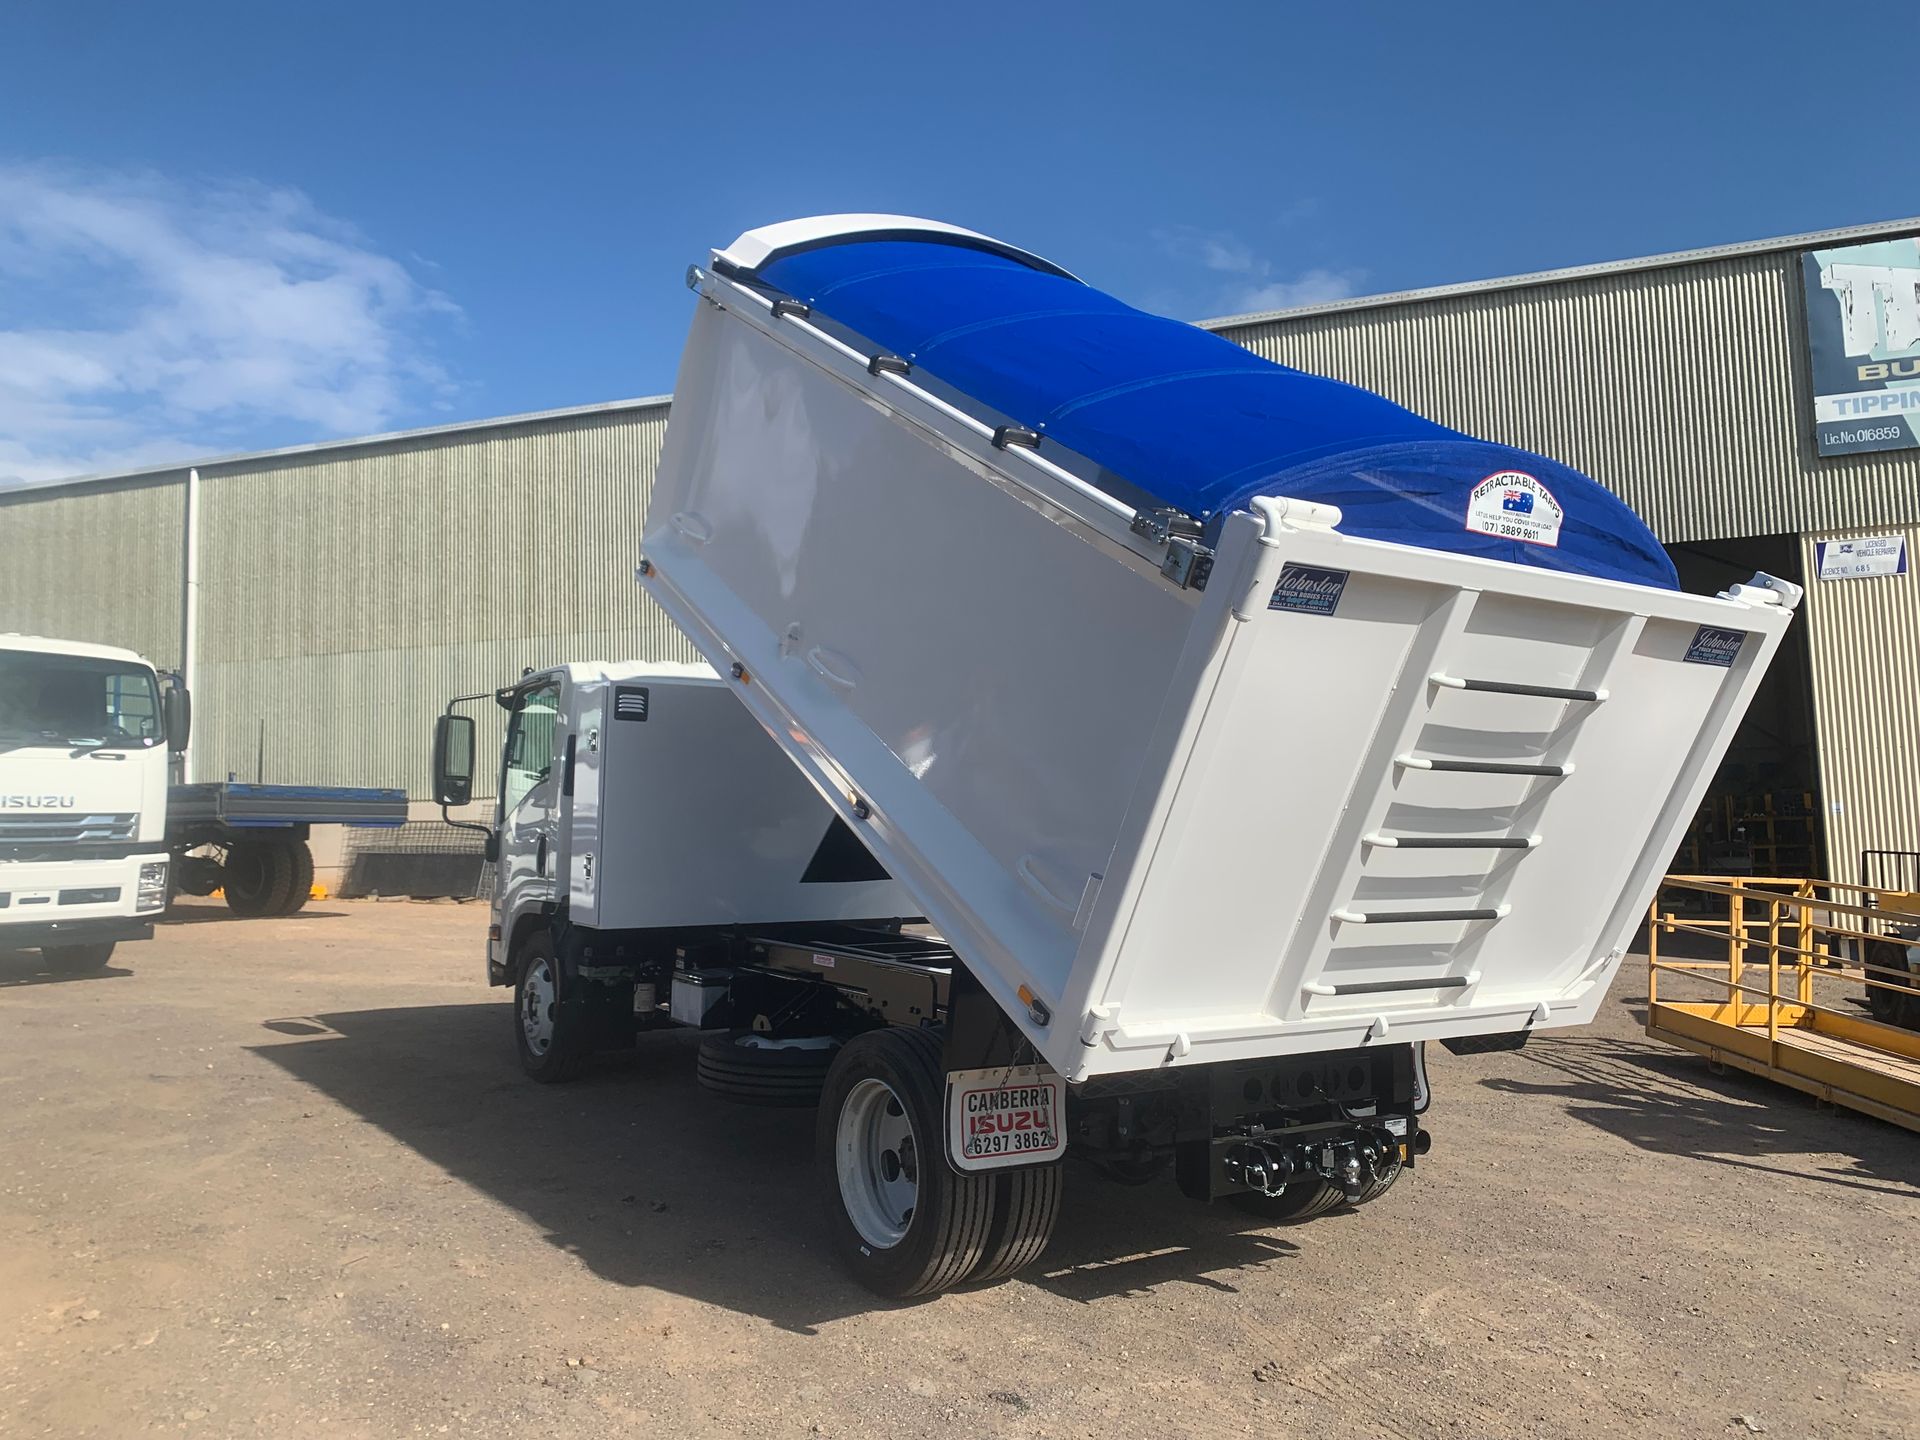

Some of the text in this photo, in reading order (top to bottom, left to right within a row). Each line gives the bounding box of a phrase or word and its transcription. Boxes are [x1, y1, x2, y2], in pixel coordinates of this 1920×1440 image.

[1473, 475, 1561, 519] RETRACTABLE TARPS
[1489, 513, 1501, 521] HELP
[1502, 516, 1513, 524] YOU
[1481, 521, 1539, 540] (07) 3889 9611
[1855, 547, 1897, 557] VEHICLE REPAIRER
[1865, 540, 1887, 548] LICENSED
[1275, 567, 1342, 594] Johnston
[1278, 589, 1298, 597] TRUCK
[1691, 630, 1741, 651] Johnston
[0, 795, 75, 808] ISUZU
[968, 1088, 1050, 1112] CANBERRA
[970, 1110, 1051, 1135] ISUZU
[974, 1131, 1048, 1154] 6297 3862
